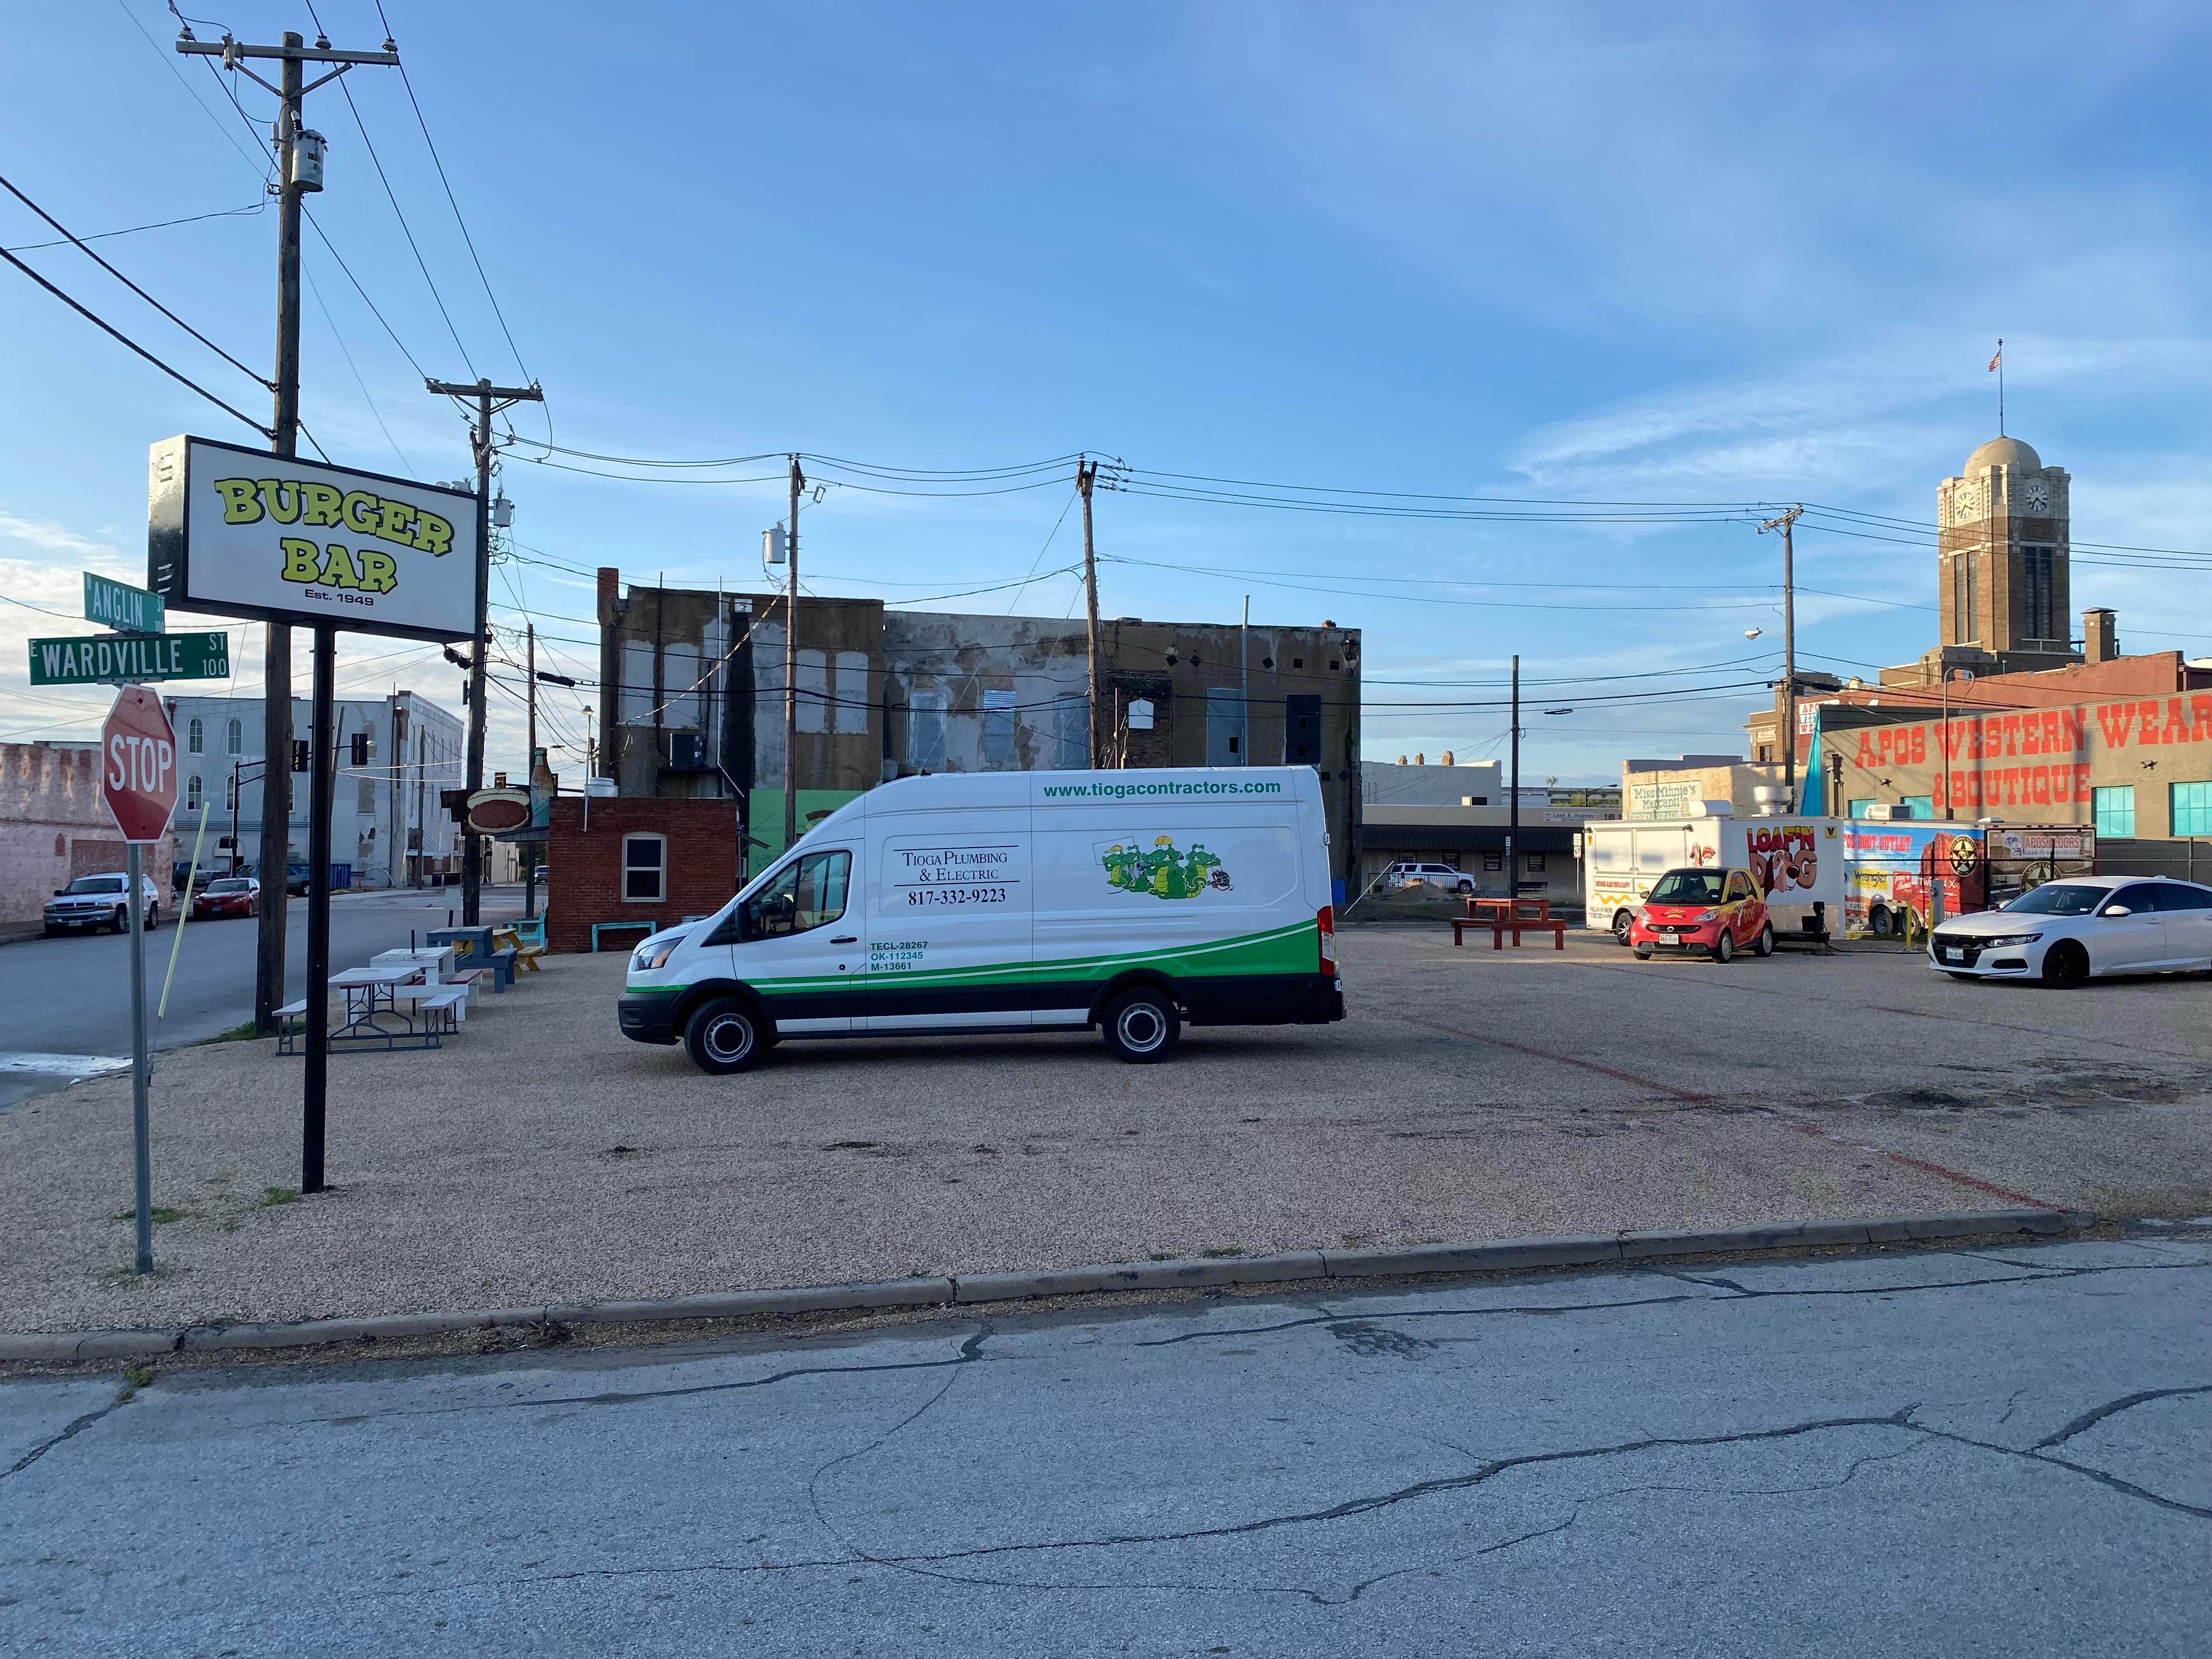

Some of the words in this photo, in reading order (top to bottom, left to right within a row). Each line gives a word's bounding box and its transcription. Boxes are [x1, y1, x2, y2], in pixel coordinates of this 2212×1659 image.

[214, 478, 454, 557] BURGER
[280, 537, 398, 595] BAR
[93, 582, 143, 627] ANGLIN
[157, 596, 165, 613] ST
[304, 589, 332, 601] Est.
[337, 592, 374, 606] 1949
[30, 640, 38, 657] E
[42, 640, 183, 678] WARDVILLE
[209, 634, 225, 651] ST
[202, 658, 227, 676] 100
[1855, 726, 1926, 768] APOS
[1934, 705, 2087, 761] WESTERN
[109, 734, 172, 793] STOP
[1043, 781, 1281, 799] www.tiogacontractors.com
[1634, 788, 1655, 799] Miss
[1657, 784, 1696, 797] Minnie's
[1932, 772, 1943, 807] &
[1949, 763, 2091, 808] BOUTIQUE
[1747, 826, 1815, 853] LOAF'N
[1880, 835, 1911, 852] OUTLET
[2025, 837, 2046, 848] APOS
[919, 868, 931, 882] &
[909, 888, 1006, 905] 817-332-9223
[870, 941, 928, 950] TECL-28267
[871, 952, 923, 961] OK-112345
[871, 962, 911, 971] M-13661
